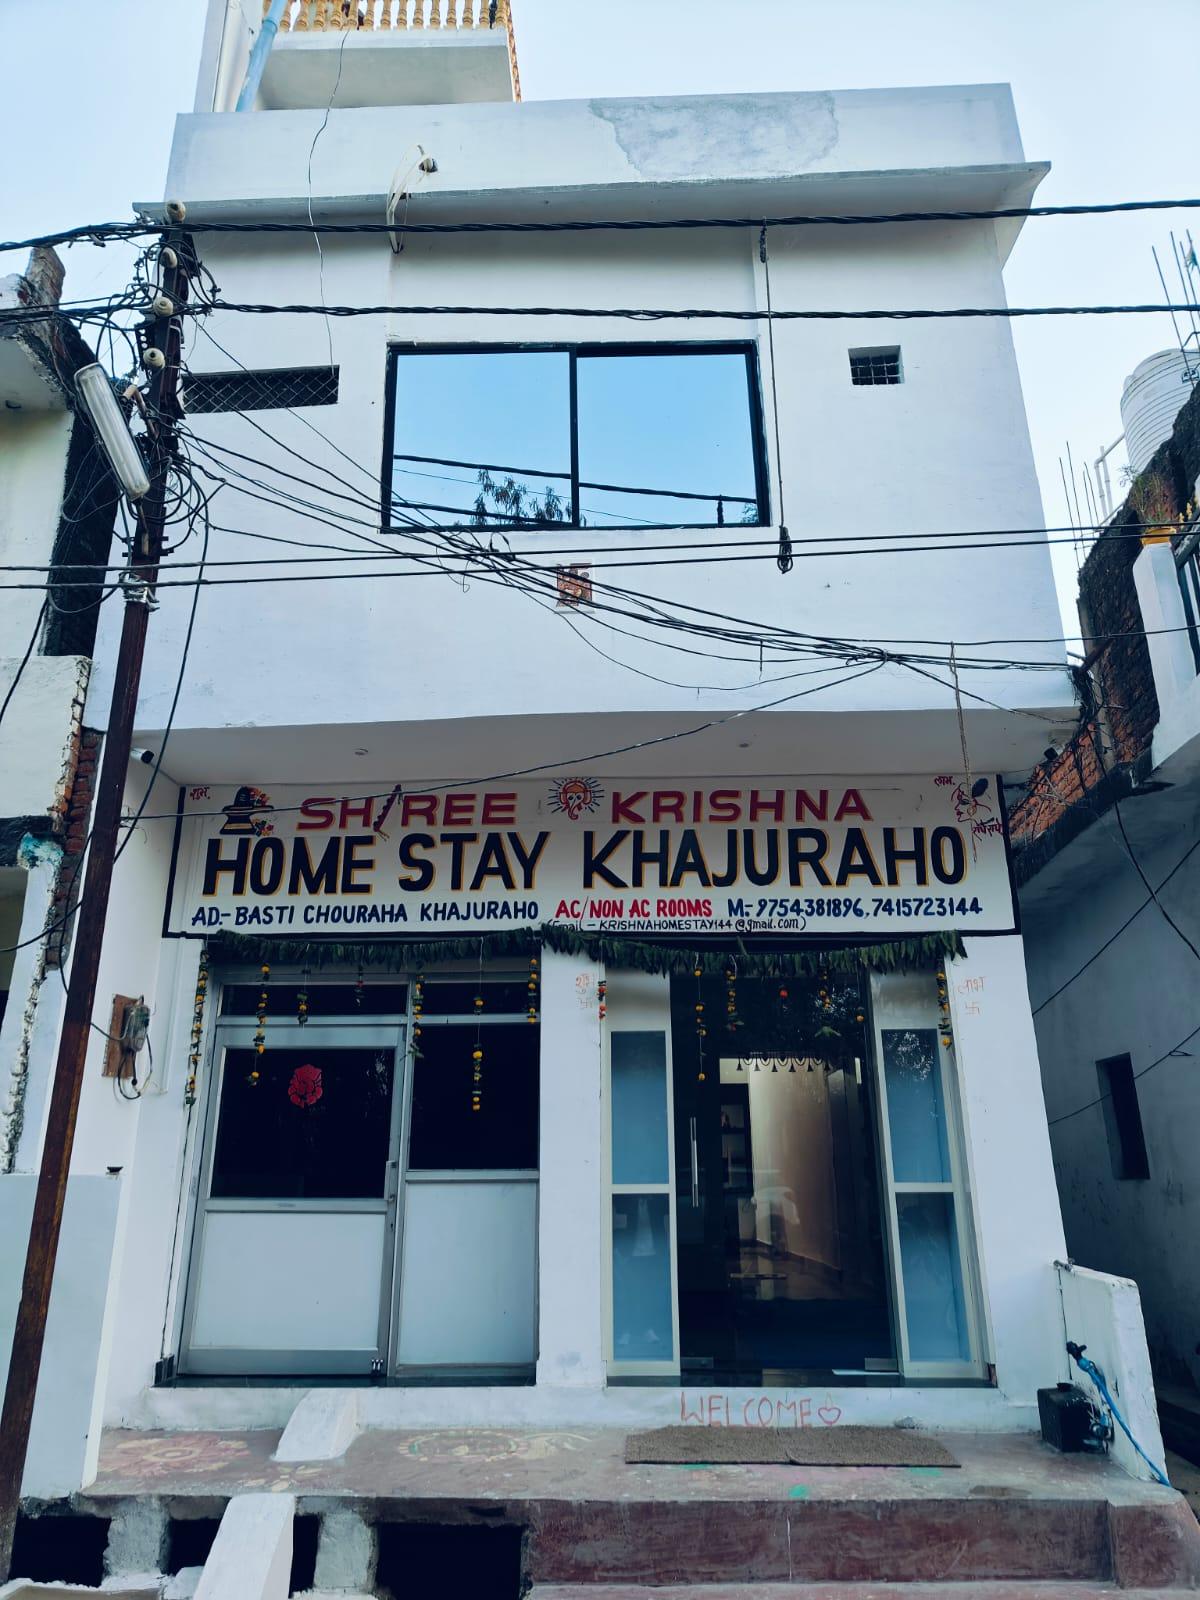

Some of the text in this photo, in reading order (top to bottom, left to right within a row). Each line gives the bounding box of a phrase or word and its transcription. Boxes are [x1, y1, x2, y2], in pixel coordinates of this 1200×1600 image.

[296, 788, 874, 831] SHREE KRISHNA
[201, 825, 968, 896] HOME STAY KHAJURAHO
[303, 903, 408, 924] CHOURAHA
[420, 900, 539, 921] KHAJURAHO
[555, 896, 624, 920] AC/NON
[629, 898, 651, 918] AC
[656, 898, 713, 918] ROOMS
[680, 1391, 812, 1428] WELCOME
